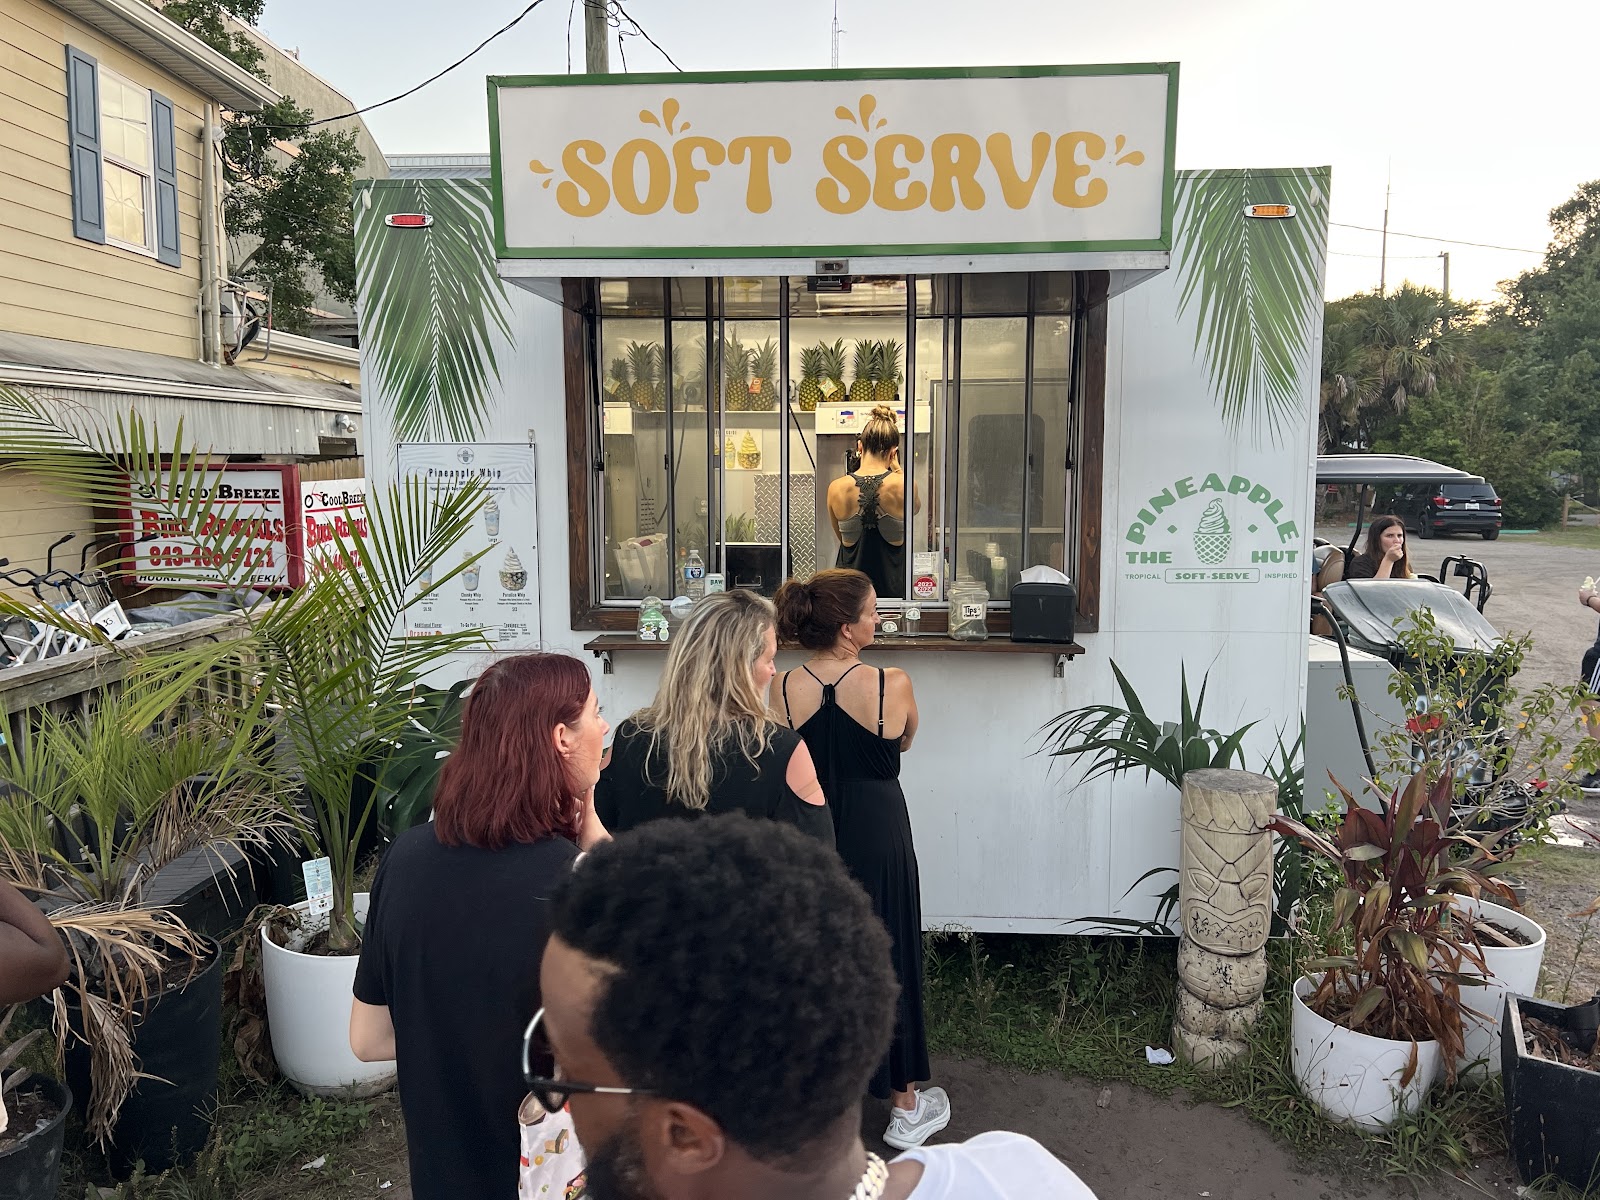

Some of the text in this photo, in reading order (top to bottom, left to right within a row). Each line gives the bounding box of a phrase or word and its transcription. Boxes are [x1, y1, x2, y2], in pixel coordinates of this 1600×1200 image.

[556, 130, 1108, 217] SOFT SERVE
[428, 468, 502, 480] Pineapple Whip
[175, 484, 280, 499] COOBREEZE
[1126, 473, 1300, 545] PINEAPPLE
[1126, 550, 1299, 564] THE HUT
[1175, 572, 1250, 581] SOFT-SERVE
[1264, 572, 1298, 580] INSPIRED
[963, 605, 978, 615] Tips
